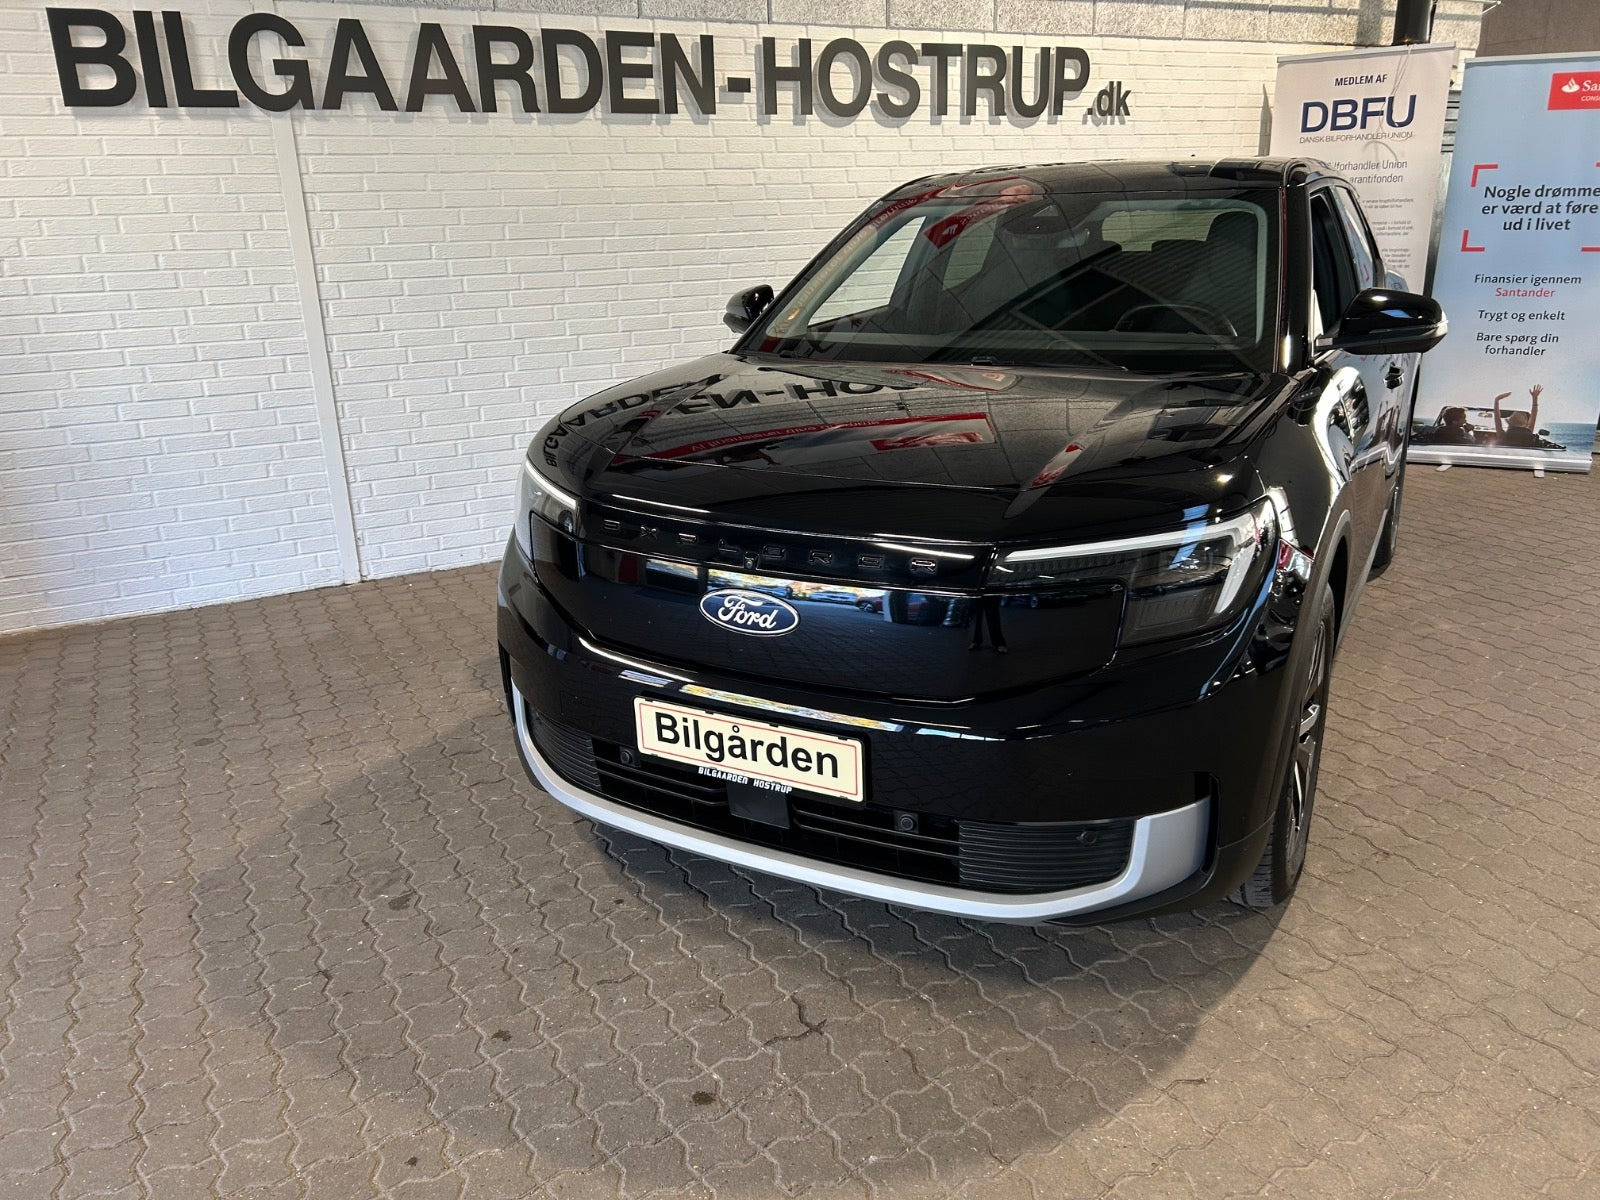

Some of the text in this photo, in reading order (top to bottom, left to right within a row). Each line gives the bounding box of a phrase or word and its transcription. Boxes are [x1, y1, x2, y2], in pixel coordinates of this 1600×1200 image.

[1334, 73, 1388, 86] MEDLEM AF
[1301, 94, 1417, 133] DBFU
[1299, 135, 1326, 145] DANSK
[1388, 131, 1413, 141] UNION
[1382, 159, 1408, 170] Union
[1484, 184, 1600, 202] Nogle drømme
[1481, 201, 1599, 215] er værd at føre
[1503, 217, 1571, 231] ud i livet
[1474, 273, 1582, 287] Finansier igennem
[1495, 287, 1556, 298] Santander
[1478, 309, 1566, 322] Trygt og enkelt
[1476, 332, 1559, 345] Bare spørg din
[1485, 345, 1546, 356] forhandler
[602, 517, 938, 574] EXPLORER
[717, 595, 779, 629] Ford
[655, 712, 839, 779] Bilgården
[698, 767, 793, 794] BILGAARDEN HOSTRUP
